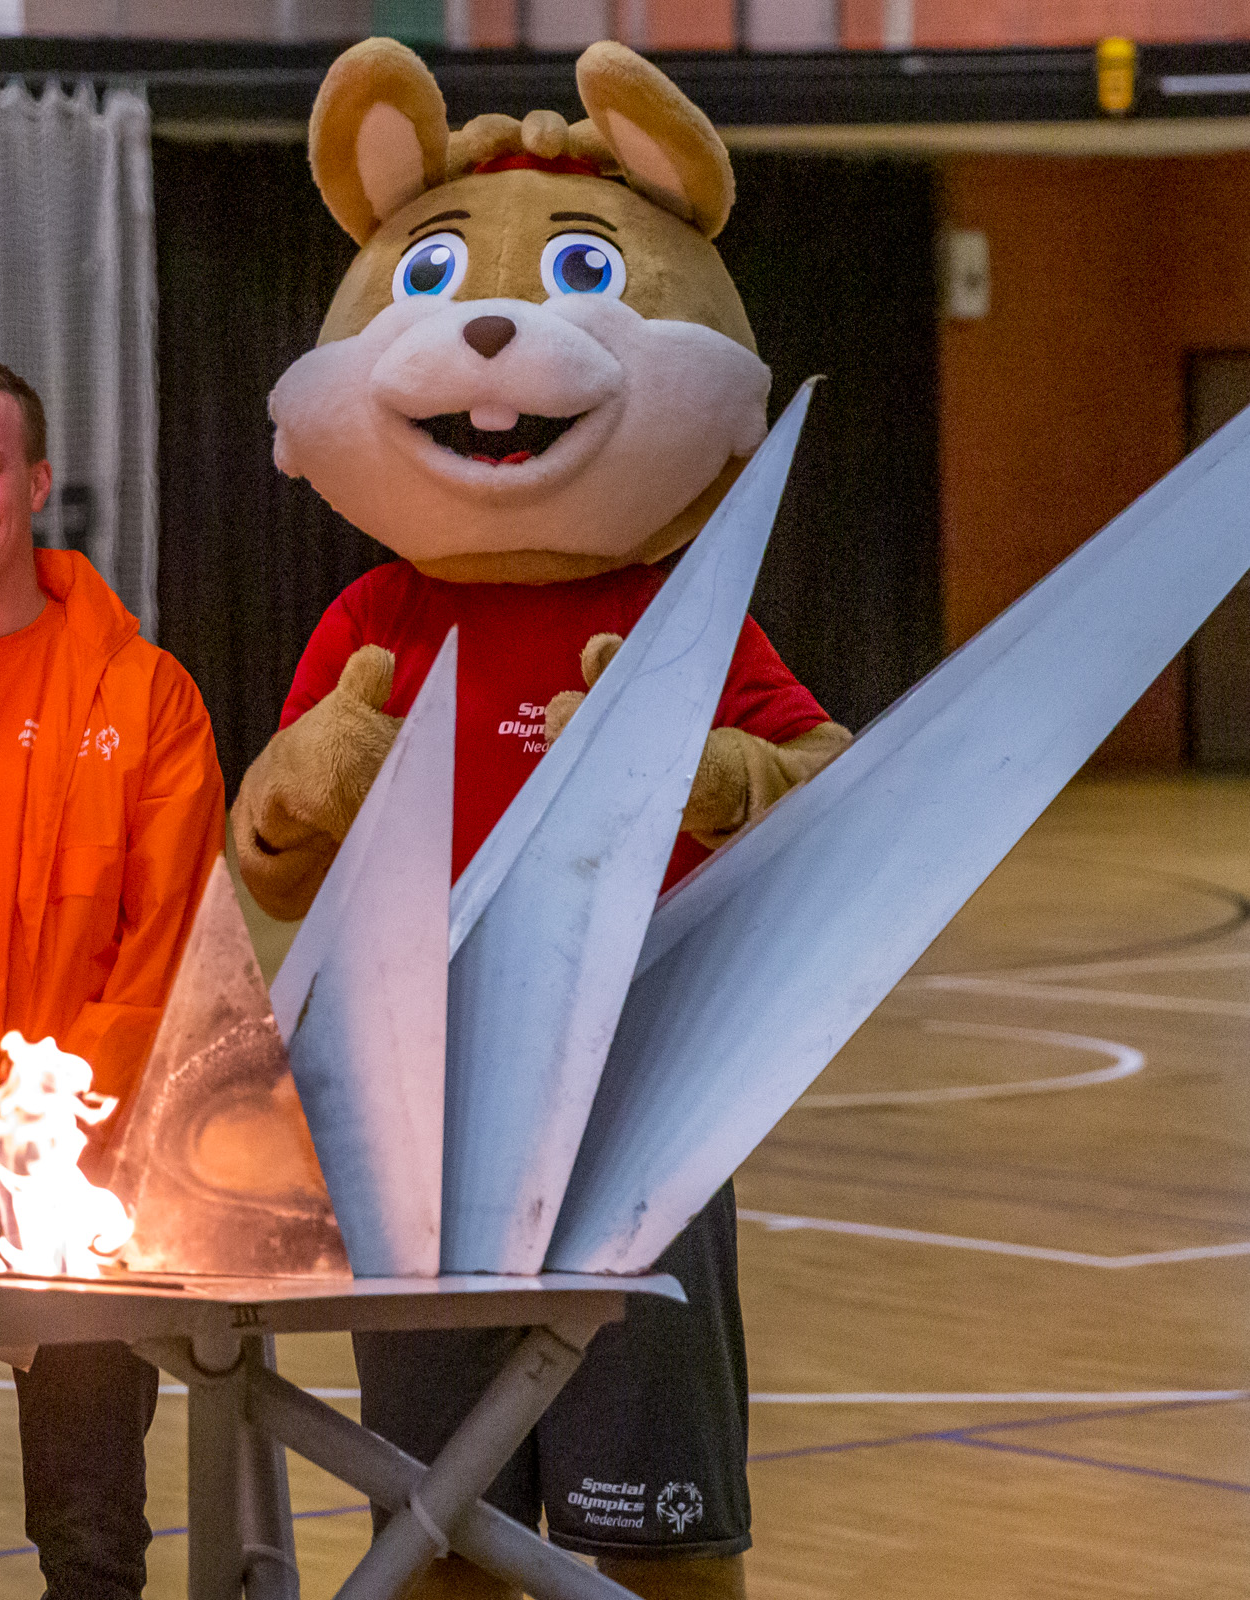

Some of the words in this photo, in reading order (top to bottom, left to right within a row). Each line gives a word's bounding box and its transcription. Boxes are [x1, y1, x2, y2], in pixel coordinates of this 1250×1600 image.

[517, 702, 546, 719] Sp
[498, 721, 546, 737] Olym
[581, 1477, 646, 1496] Special
[567, 1492, 646, 1512] Olympics
[584, 1512, 645, 1529] Nederland
